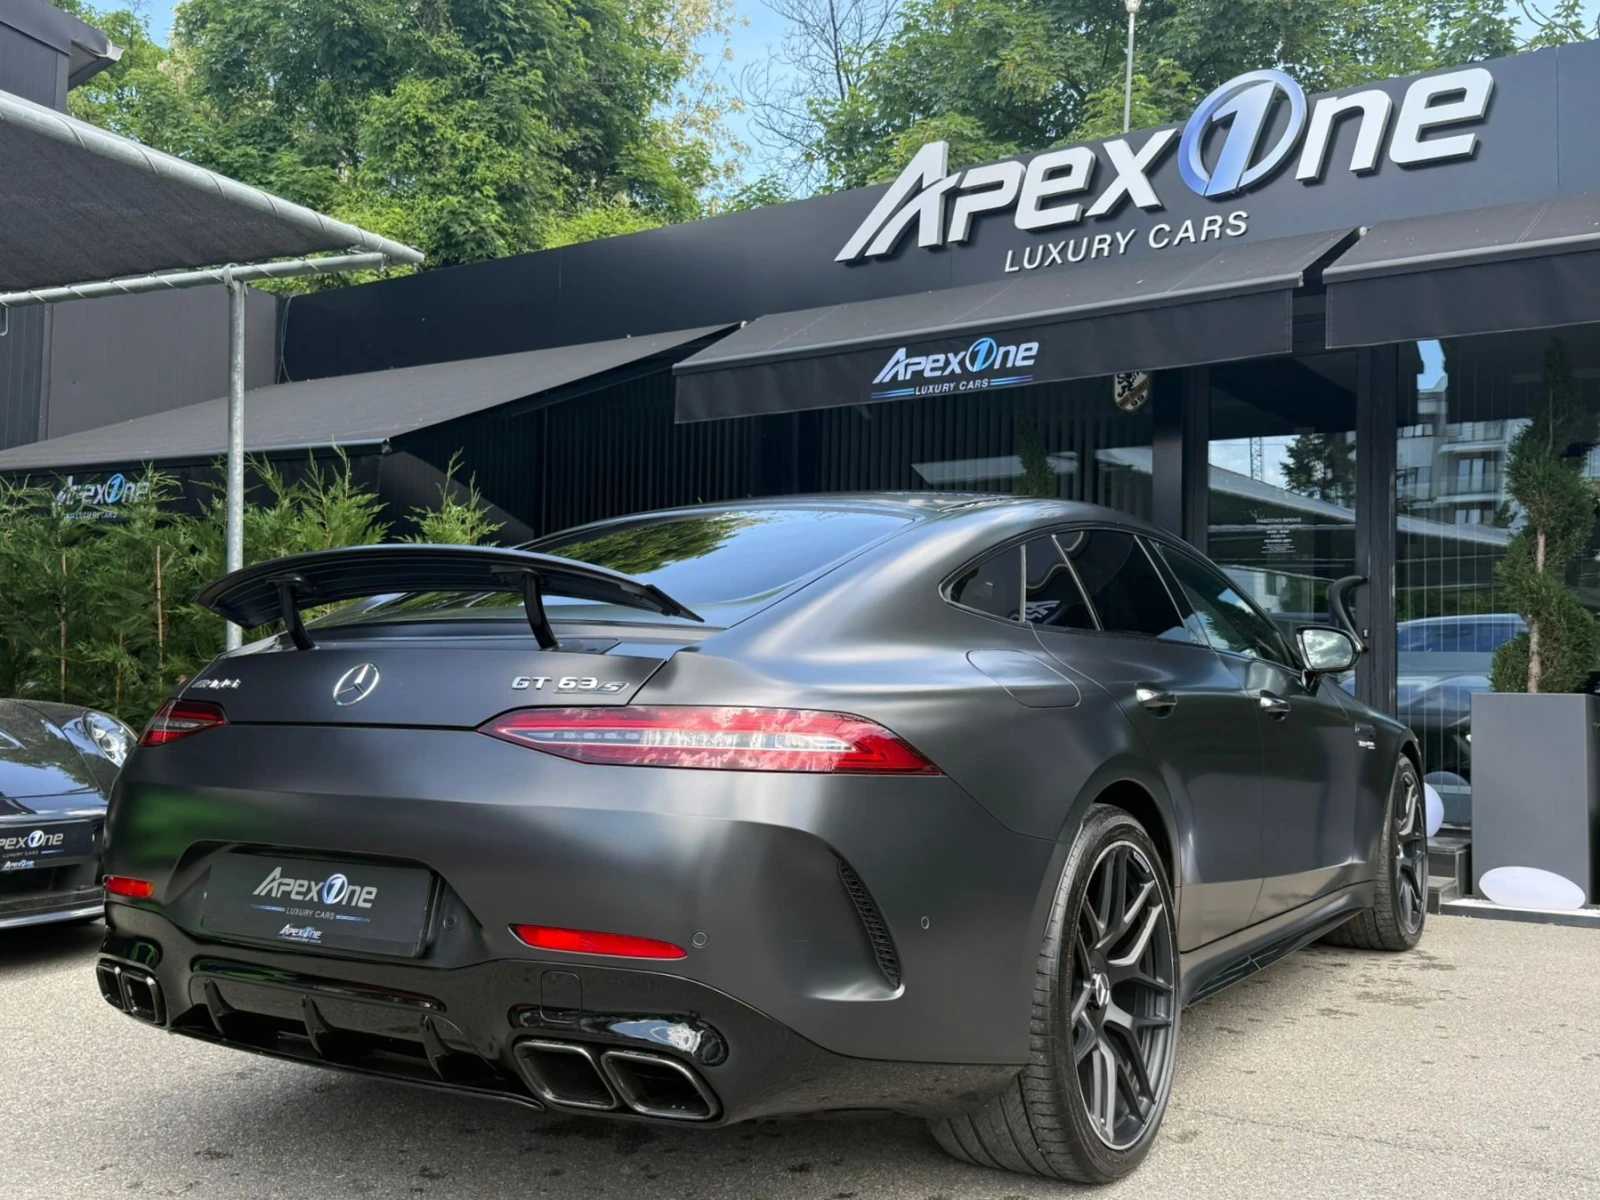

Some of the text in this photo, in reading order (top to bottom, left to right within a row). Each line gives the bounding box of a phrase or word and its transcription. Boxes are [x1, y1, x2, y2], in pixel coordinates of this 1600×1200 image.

[1004, 211, 1248, 272] LUXURY CARS
[915, 378, 989, 395] LUXURY CARS
[511, 676, 552, 690] GT
[557, 676, 598, 690] 63
[286, 907, 336, 920] LUXURY CARS
